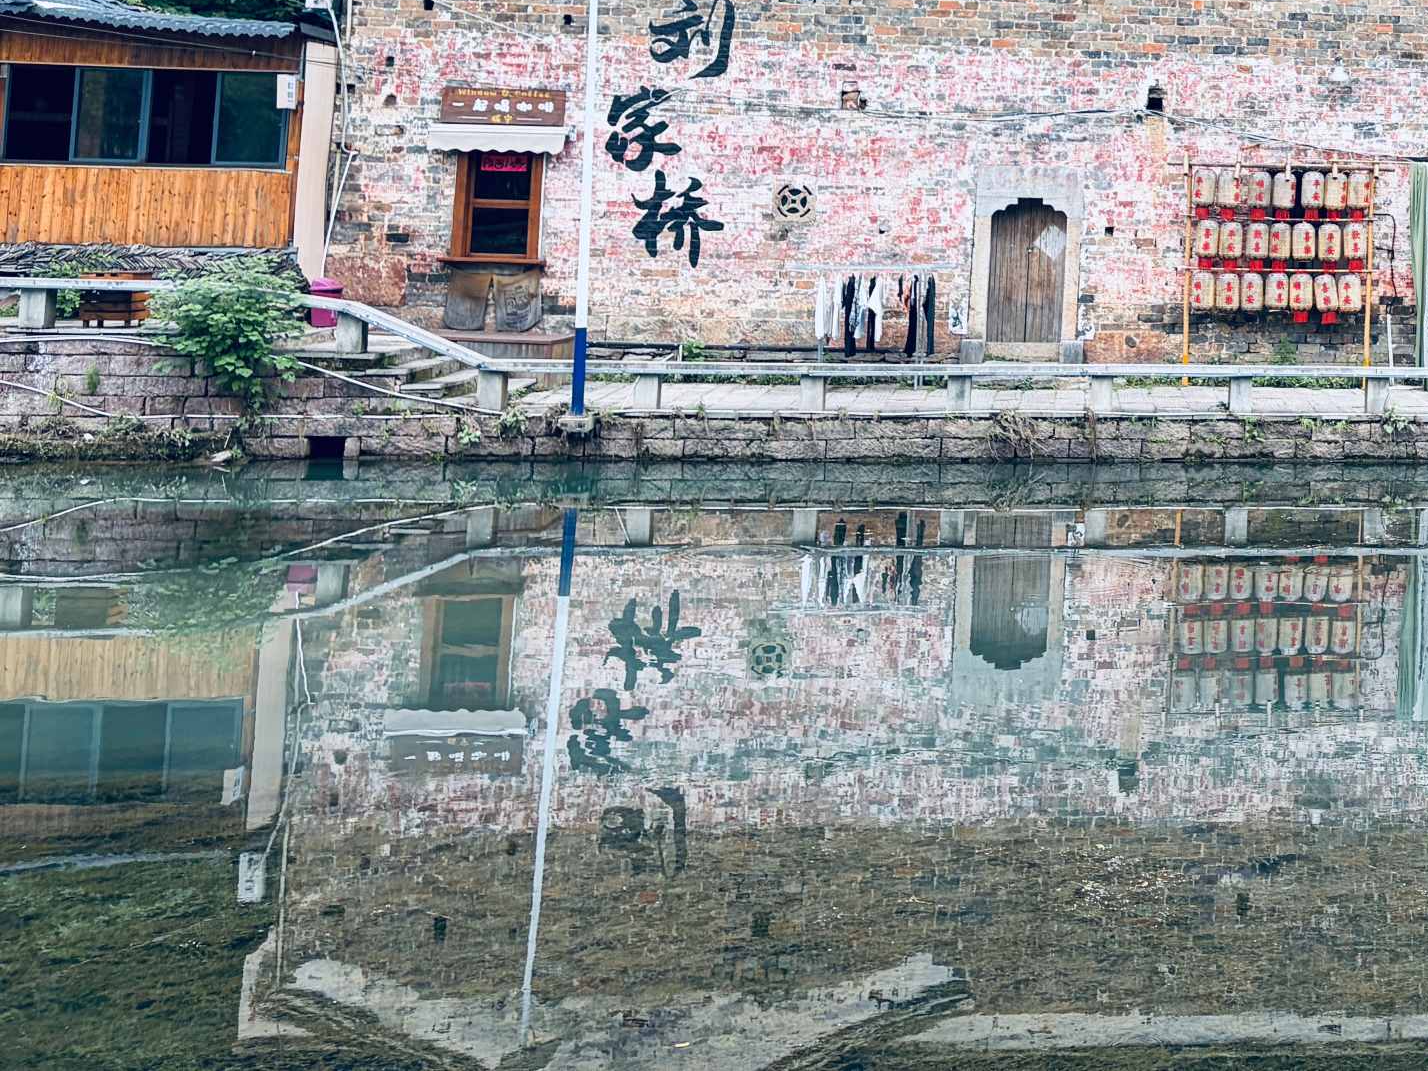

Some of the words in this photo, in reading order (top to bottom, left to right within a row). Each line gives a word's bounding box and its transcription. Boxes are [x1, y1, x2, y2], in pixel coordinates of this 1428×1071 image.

[452, 98, 554, 113] 一起喝咖啡
